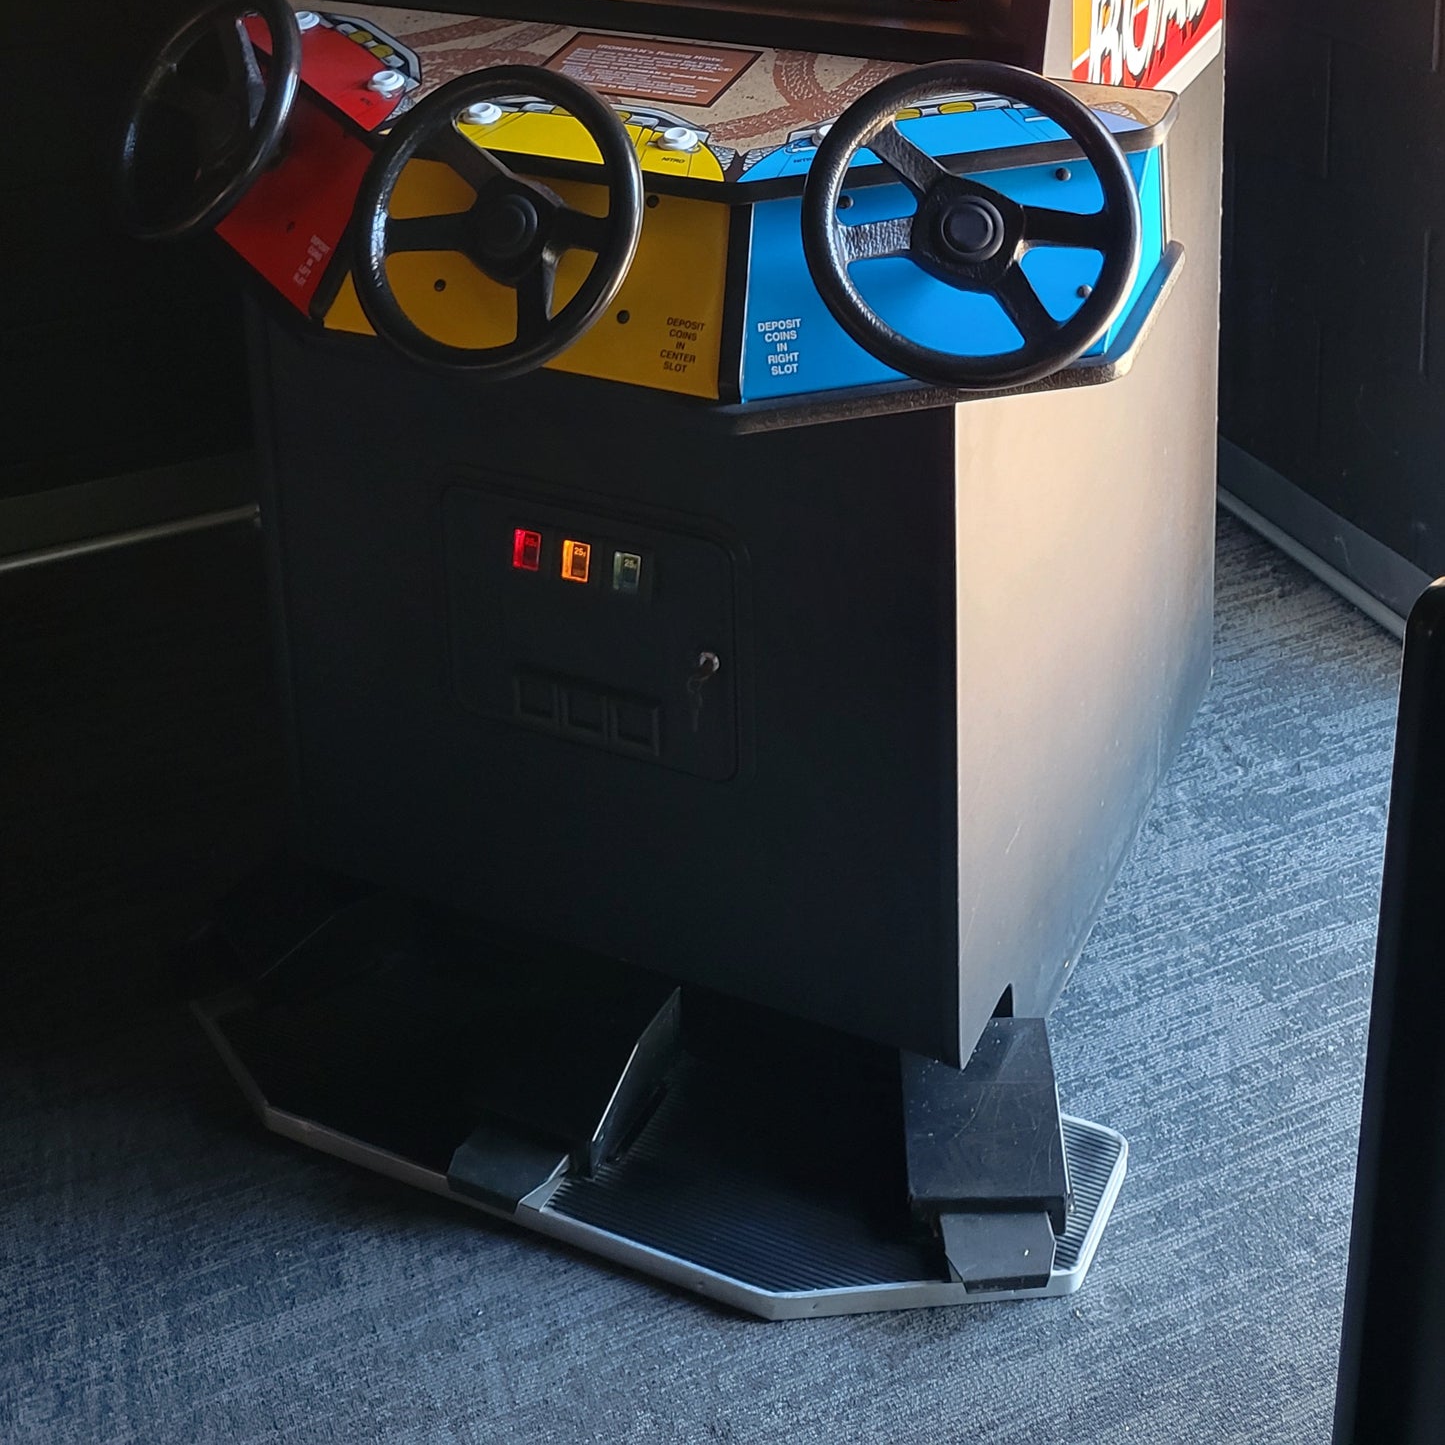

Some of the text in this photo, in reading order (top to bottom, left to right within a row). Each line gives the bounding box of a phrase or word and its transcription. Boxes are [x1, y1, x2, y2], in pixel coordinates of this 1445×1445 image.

[793, 156, 812, 164] NITR
[666, 316, 706, 331] DEPOSIT
[757, 318, 801, 333] DEPOSIT
[669, 328, 698, 341] COINS
[764, 330, 797, 343] COINS
[675, 341, 685, 350] IN
[776, 343, 788, 352] IN
[659, 349, 696, 363] CENTER
[767, 352, 799, 365] RIGHT
[663, 361, 687, 373] SLOT
[771, 363, 799, 376] SLOT
